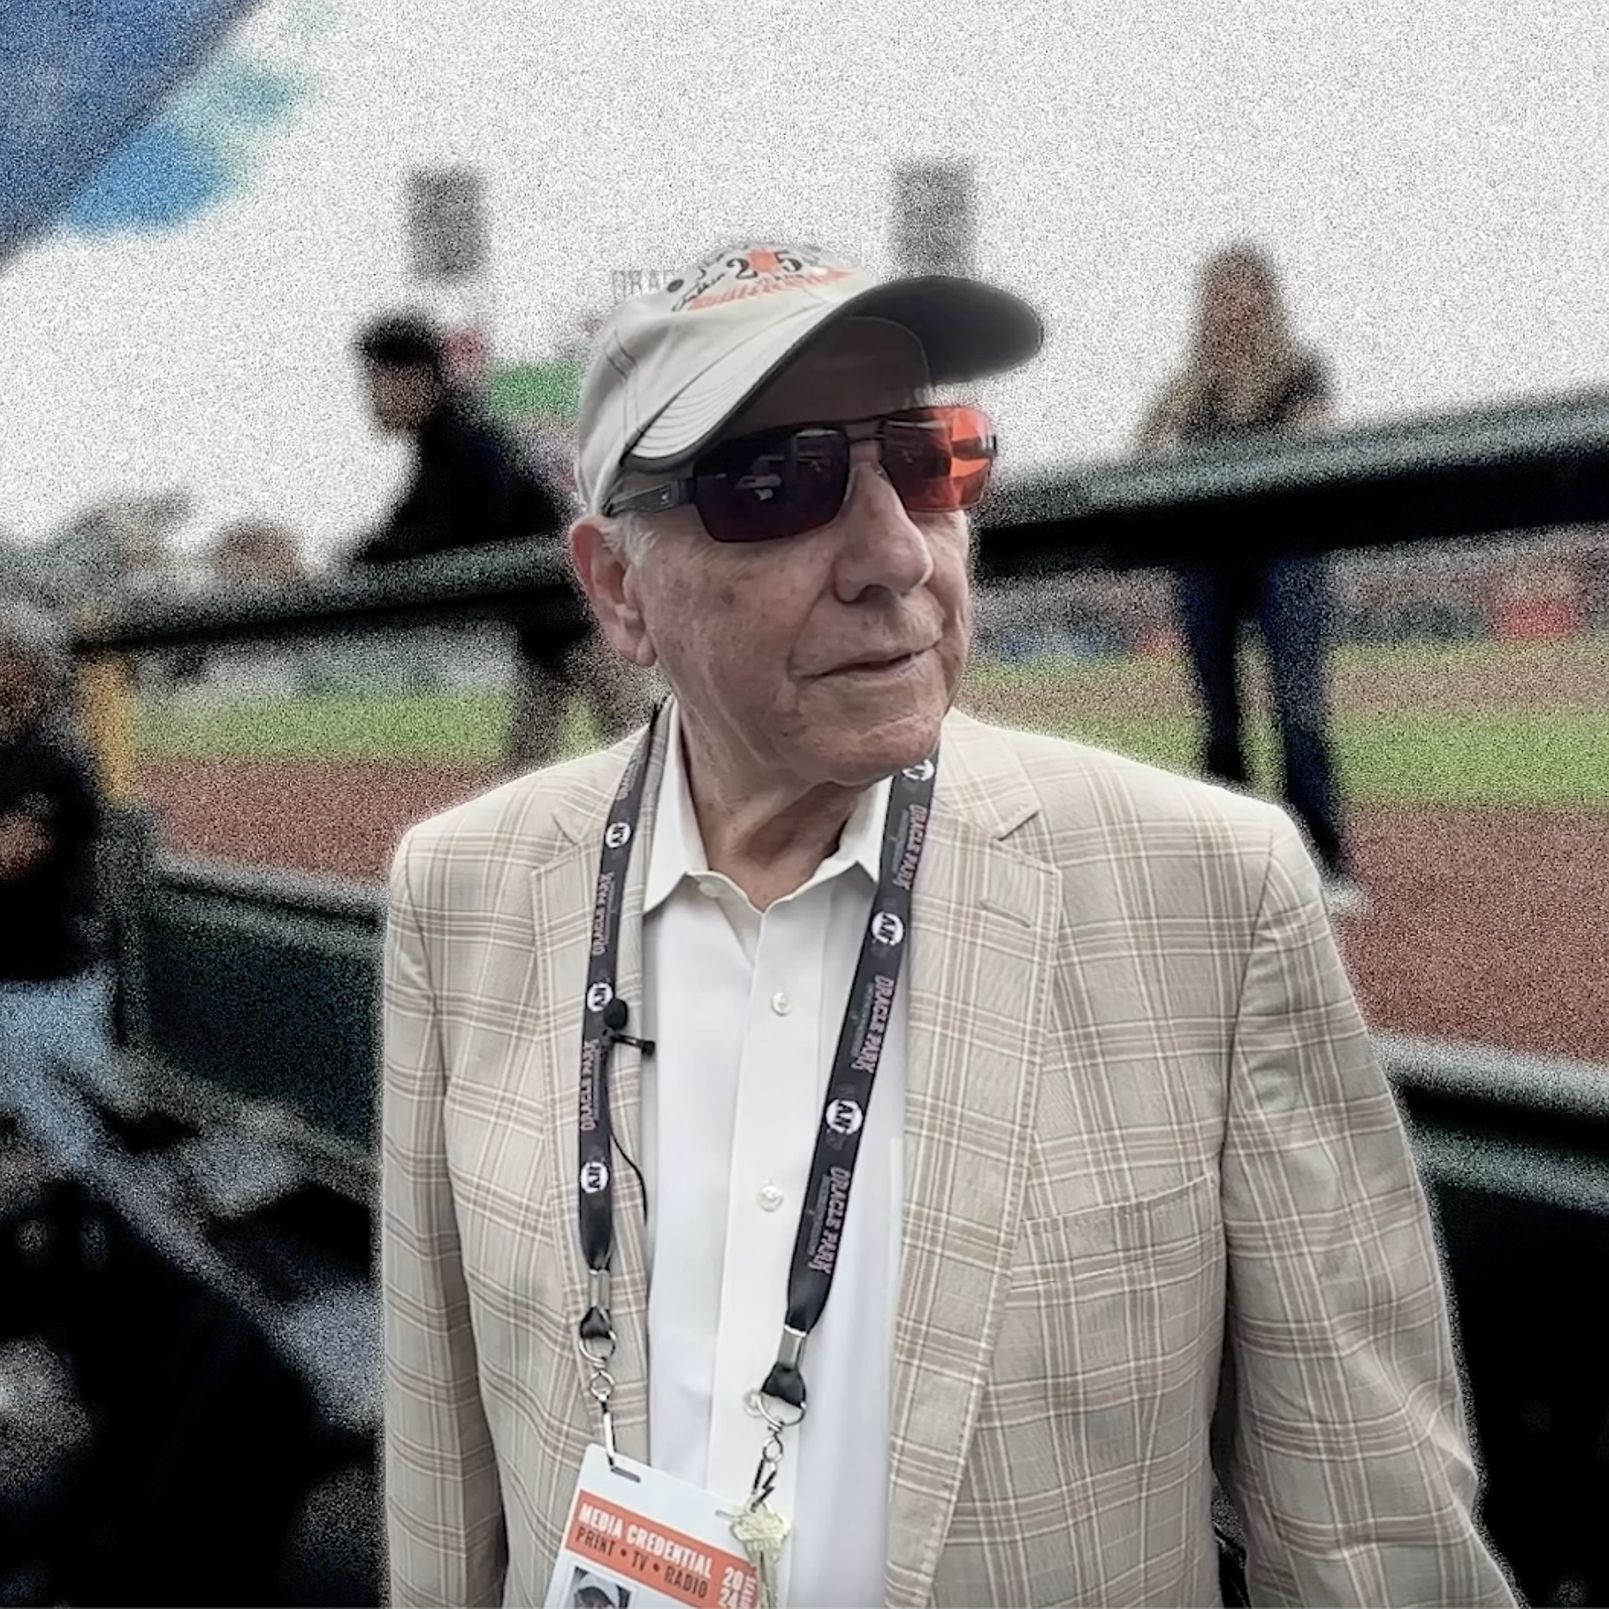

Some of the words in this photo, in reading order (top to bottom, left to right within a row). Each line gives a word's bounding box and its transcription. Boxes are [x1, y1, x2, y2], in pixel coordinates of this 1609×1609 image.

[906, 803, 928, 853] ORACLE
[892, 851, 918, 891] PARK
[868, 973, 895, 1034] ORACLE
[581, 1038, 600, 1077] PARK
[850, 1033, 883, 1075] PARK
[579, 1078, 597, 1132] ORACLE
[825, 1165, 851, 1231] ORACLE
[807, 1229, 839, 1275] PARK
[574, 1525, 616, 1557] PRINT
[630, 1550, 650, 1572] TV
[663, 1563, 709, 1599] RADIO
[577, 1502, 624, 1539] MEDIA
[626, 1524, 713, 1579] CREDENTIAL
[721, 1565, 745, 1592] 20
